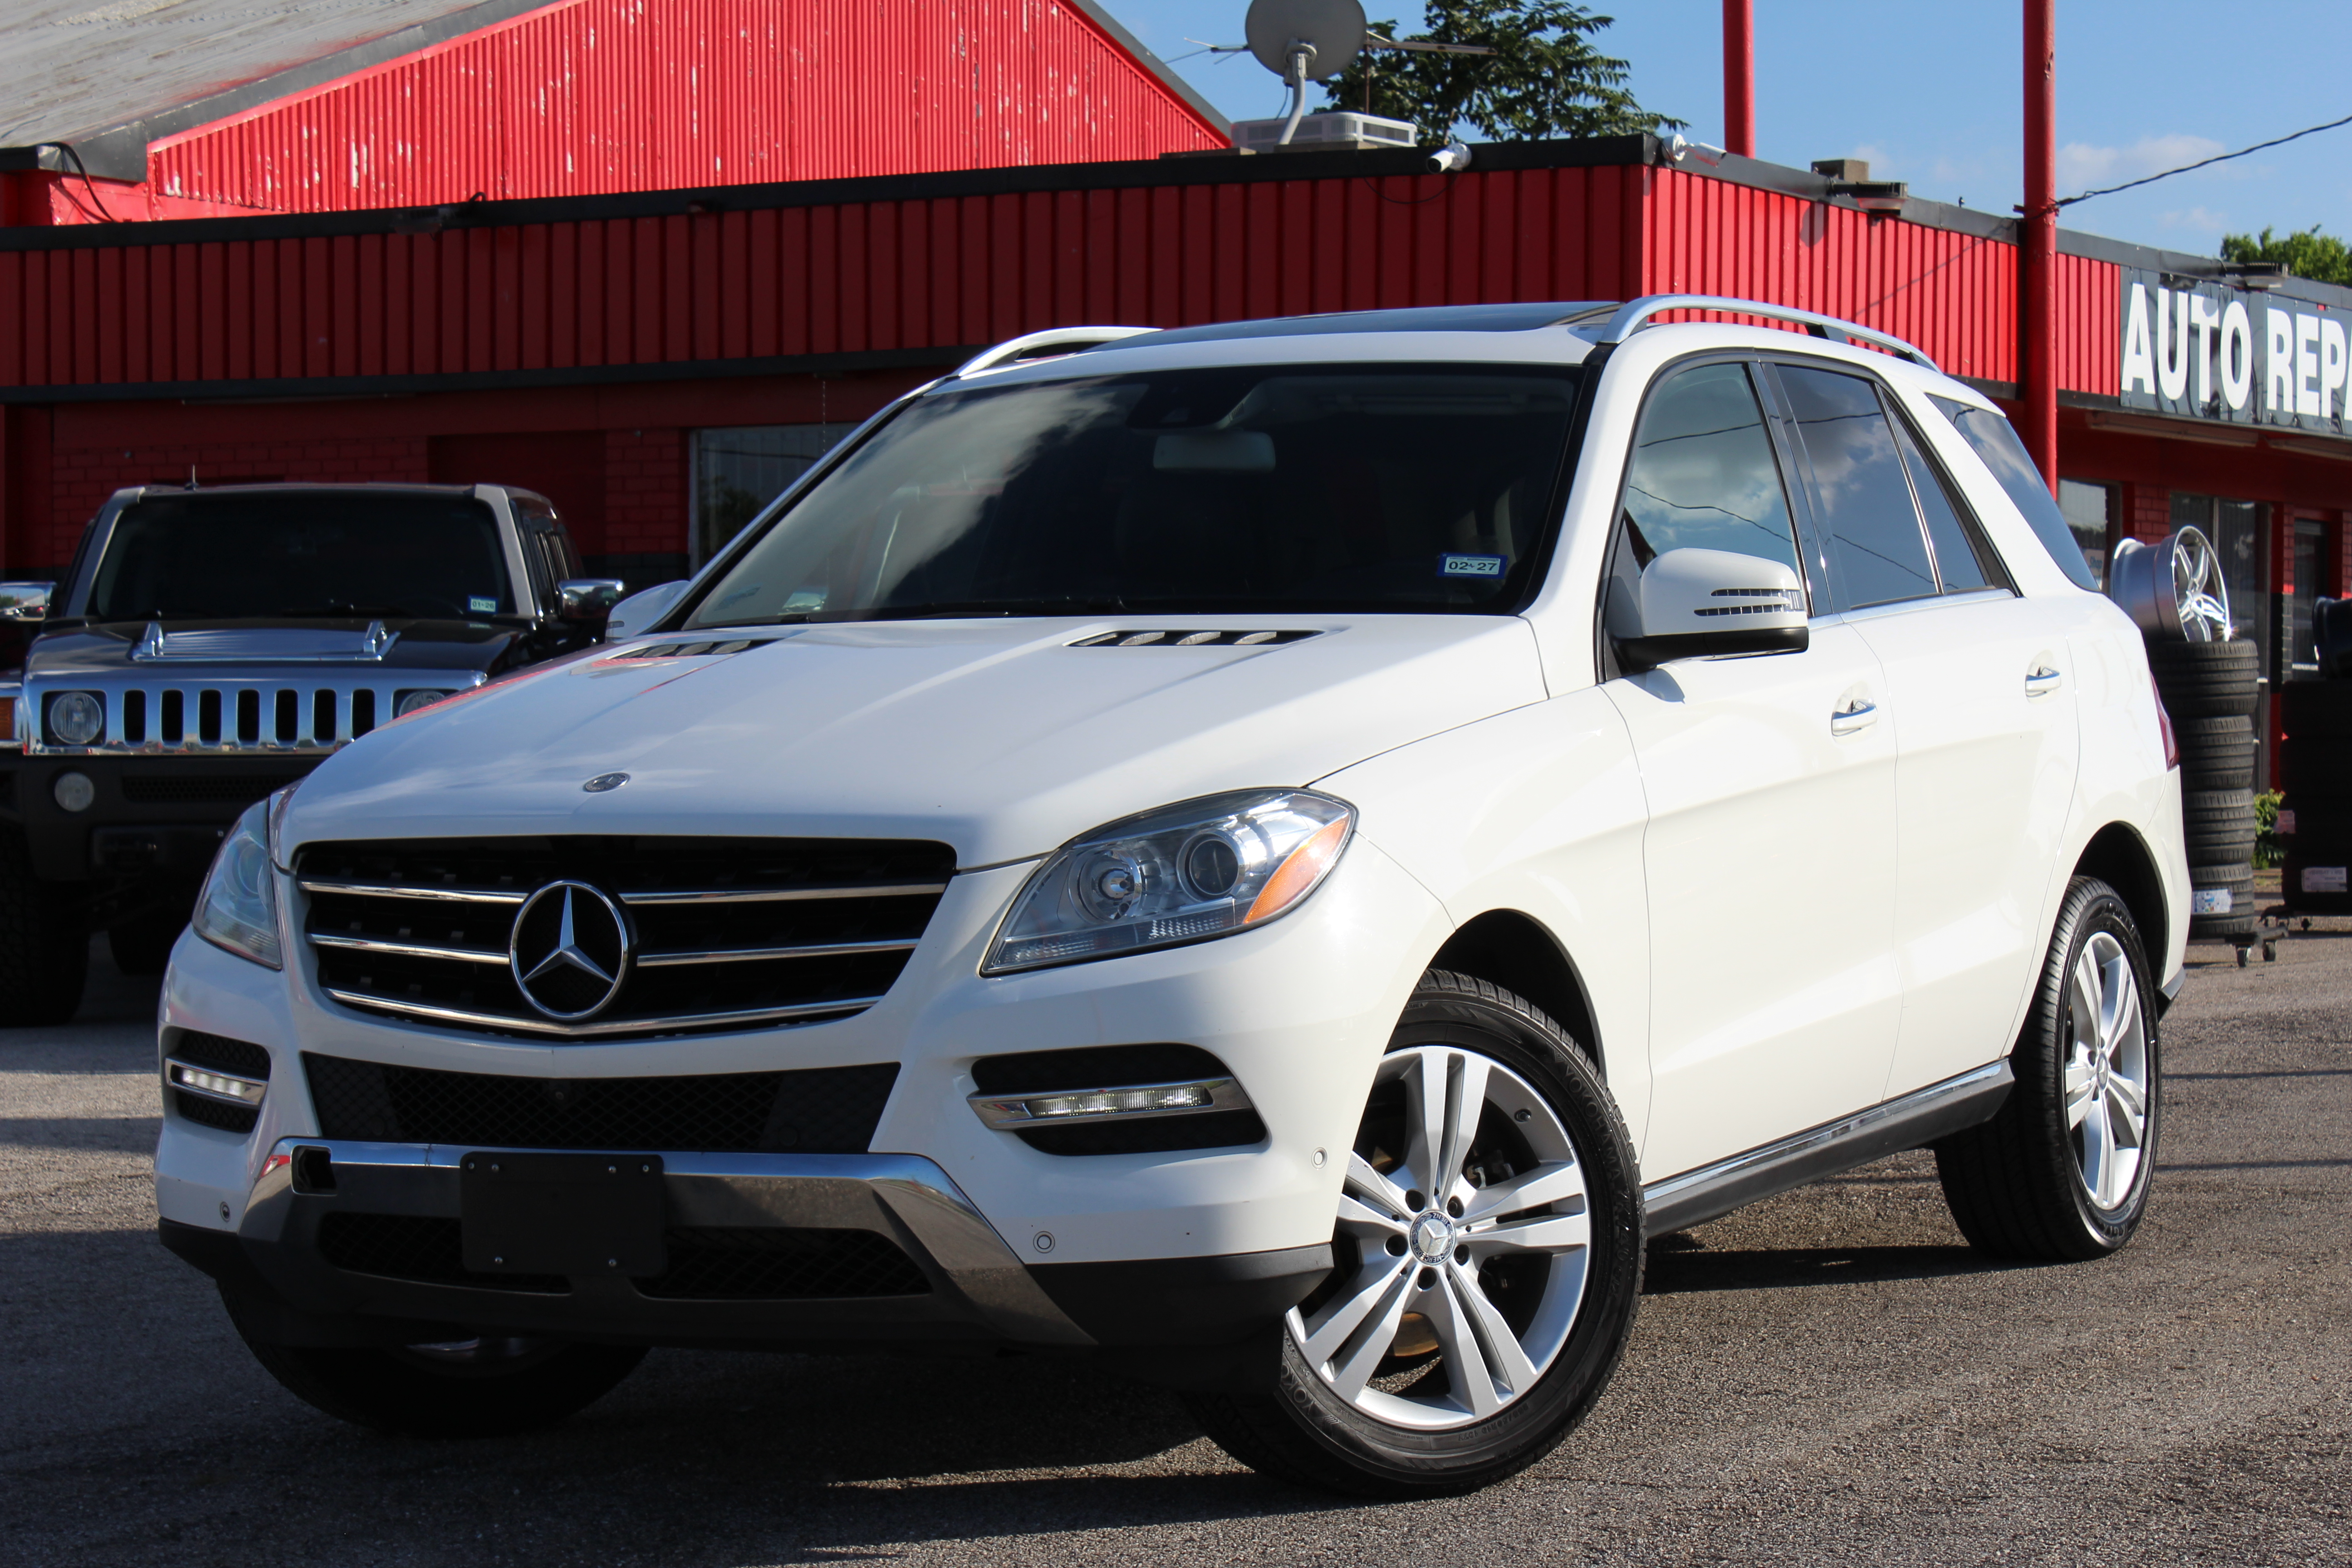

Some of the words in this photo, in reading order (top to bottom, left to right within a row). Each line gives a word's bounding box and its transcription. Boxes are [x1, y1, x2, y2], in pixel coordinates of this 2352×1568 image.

[2121, 282, 2252, 410] AUTO
[2267, 308, 2352, 421] REP
[1561, 1063, 1622, 1181] YOKOHAMA
[1414, 1243, 1443, 1263] MERCEDES
[1432, 1212, 1449, 1225] BENZ
